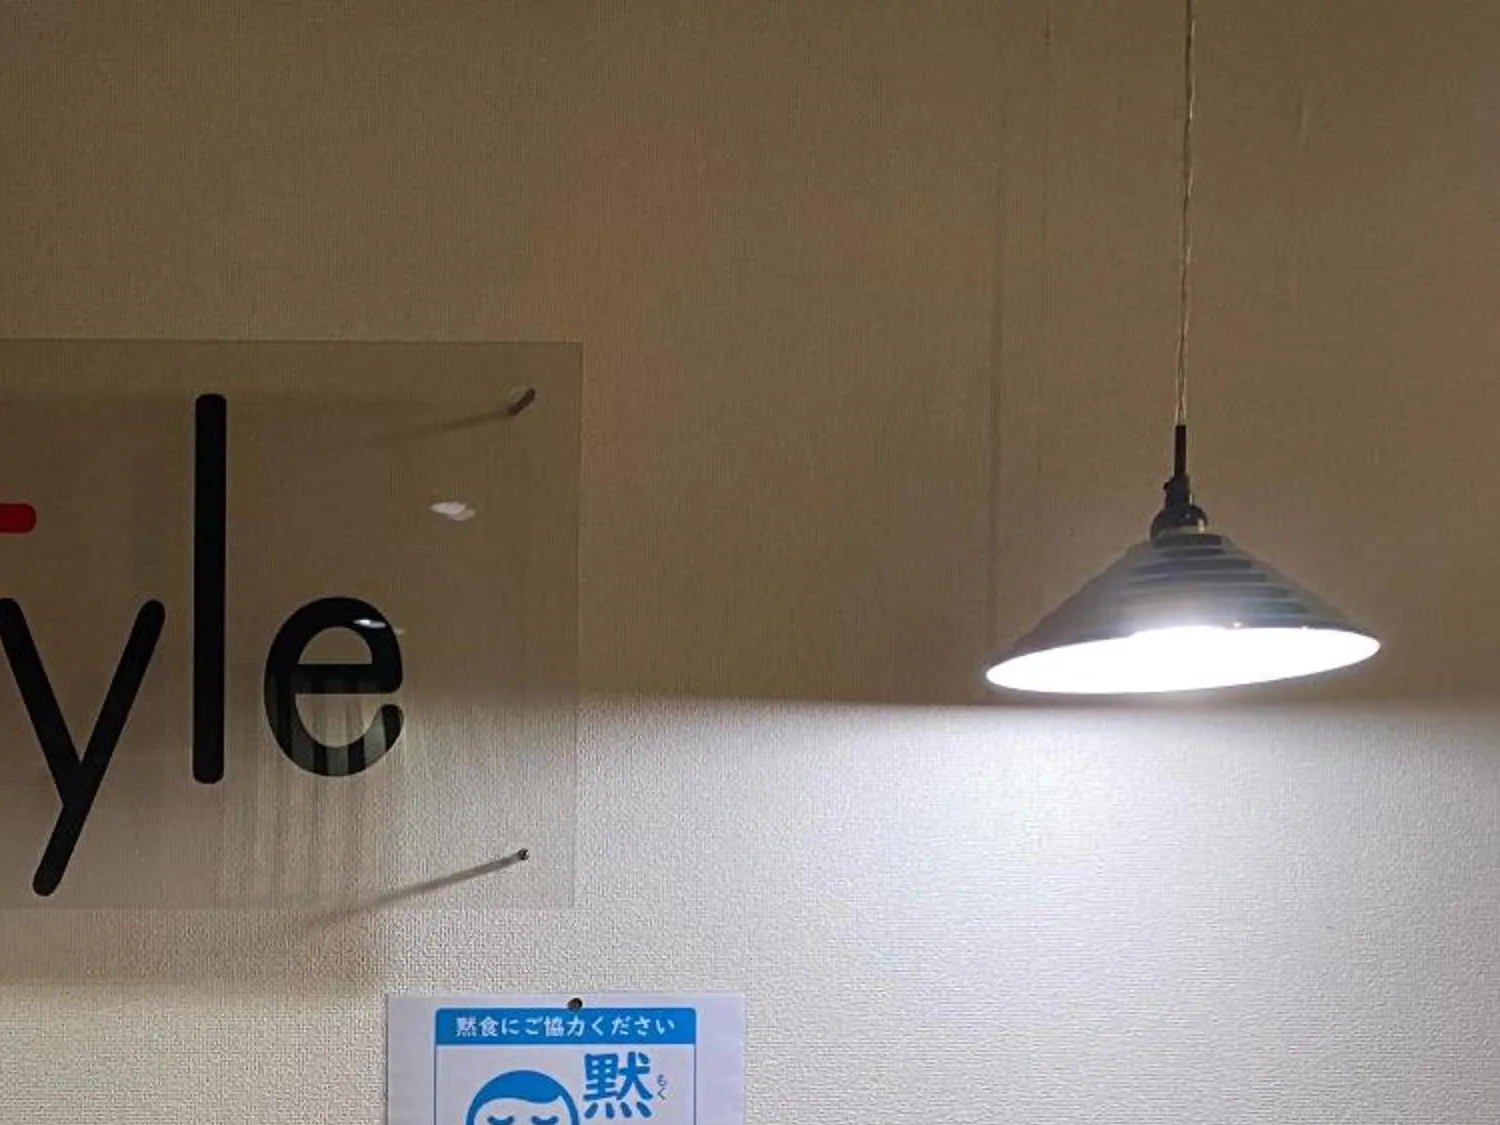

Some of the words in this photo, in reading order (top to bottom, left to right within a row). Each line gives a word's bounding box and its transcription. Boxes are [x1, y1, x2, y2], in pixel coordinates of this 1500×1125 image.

[455, 1016, 676, 1037] 黙食にご協力ください
